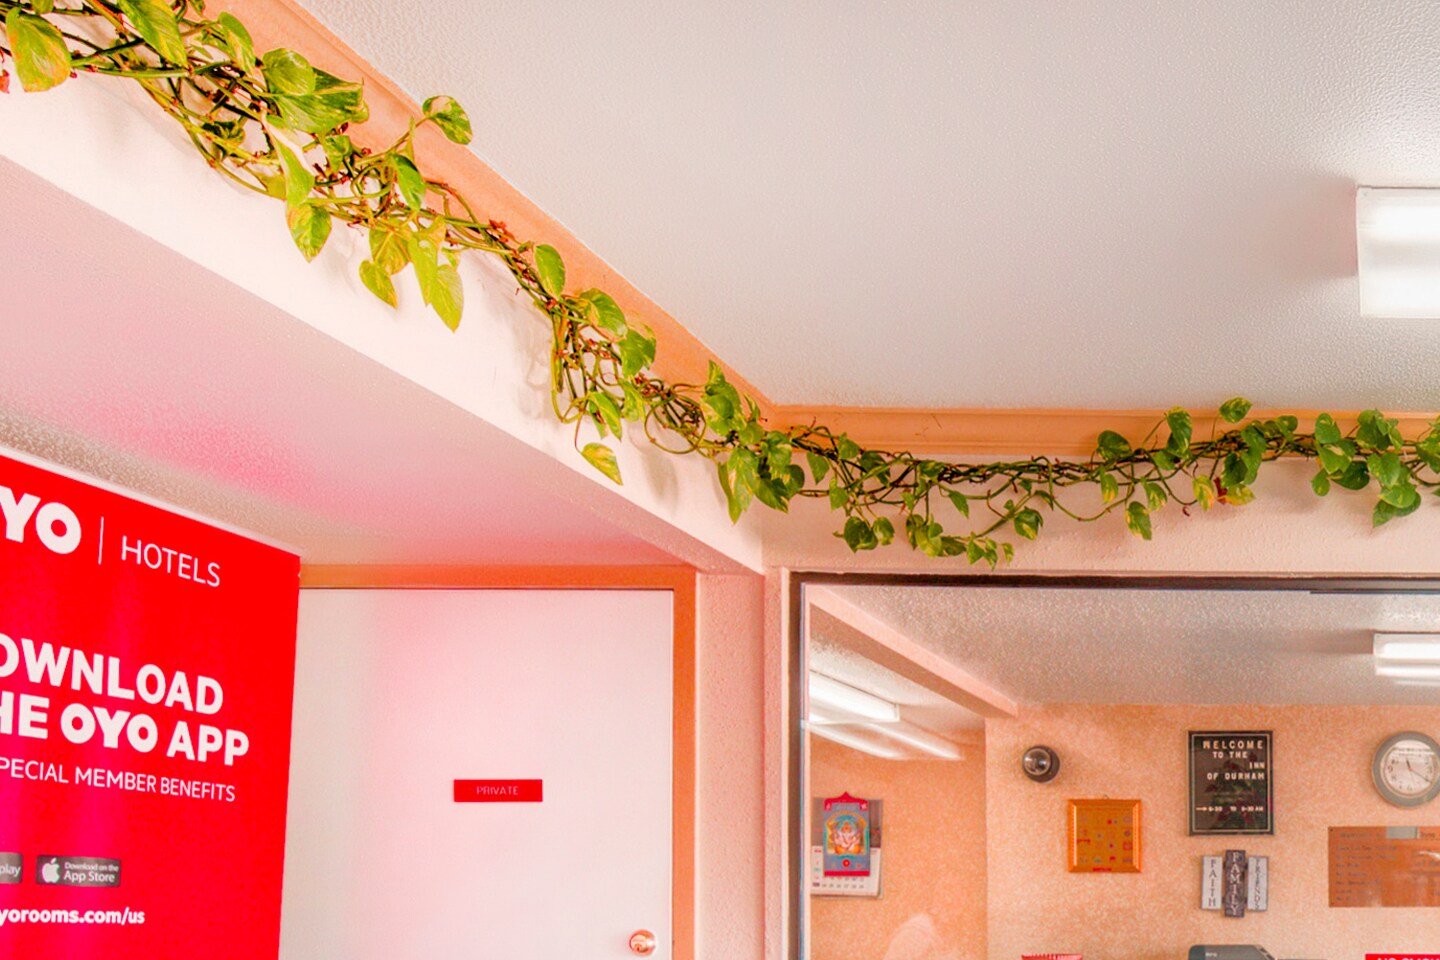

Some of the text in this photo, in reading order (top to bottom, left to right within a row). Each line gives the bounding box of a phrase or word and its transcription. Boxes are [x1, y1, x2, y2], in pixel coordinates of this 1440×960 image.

[121, 535, 221, 587] HOTELS
[60, 703, 158, 753] OYO
[166, 720, 250, 767] APP
[1202, 740, 1263, 749] WELCOME
[1213, 751, 1248, 759] TO THE
[1207, 772, 1265, 780] OF DURHAM
[75, 766, 156, 793] MEMBER
[160, 776, 236, 802] BENEFITS
[476, 785, 519, 795] PRIVATE
[64, 862, 98, 871] Download
[63, 870, 115, 883] App Store
[1209, 858, 1217, 907] FAITH
[1230, 852, 1241, 916] FAMILY
